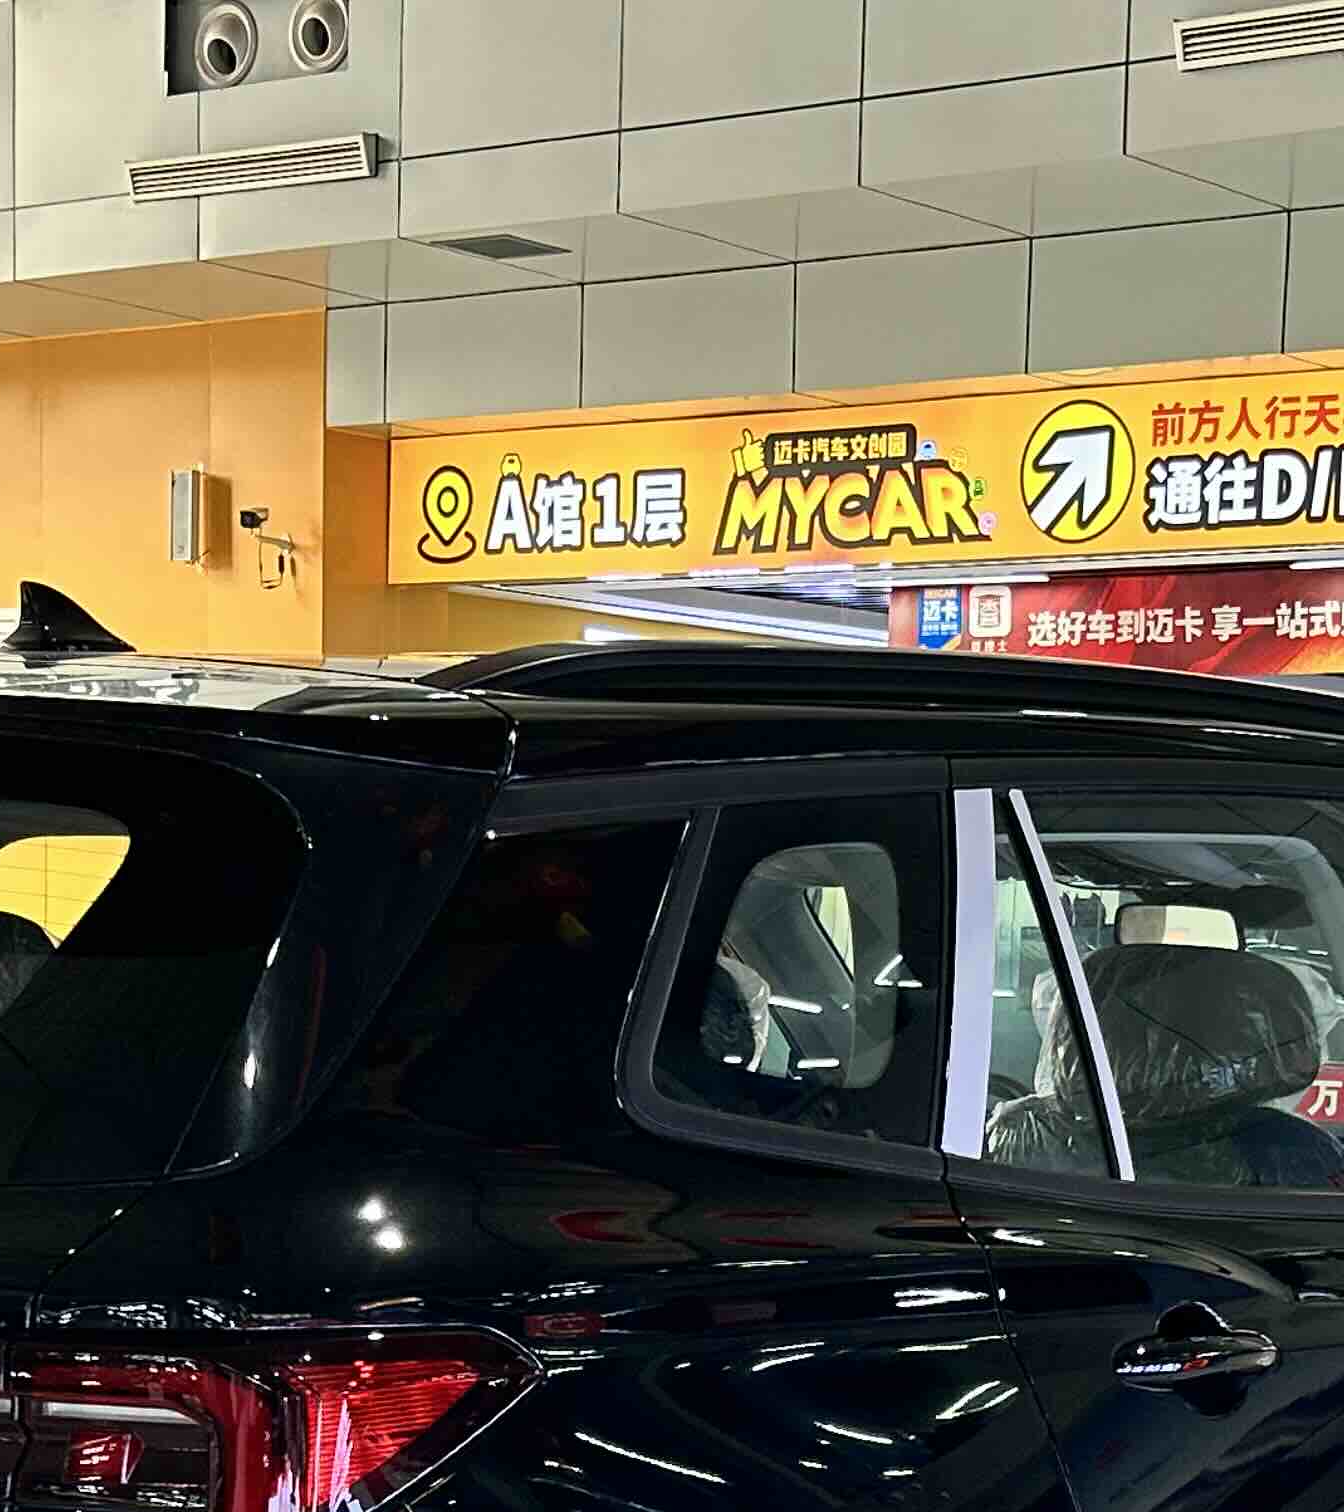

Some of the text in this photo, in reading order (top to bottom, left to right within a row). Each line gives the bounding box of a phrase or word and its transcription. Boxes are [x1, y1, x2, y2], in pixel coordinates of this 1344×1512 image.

[772, 434, 908, 464] 迈卡汽车文创园
[487, 472, 686, 551] A馆1层
[722, 468, 973, 550] MYCAR
[1027, 607, 1205, 648] 选好车到迈卡
